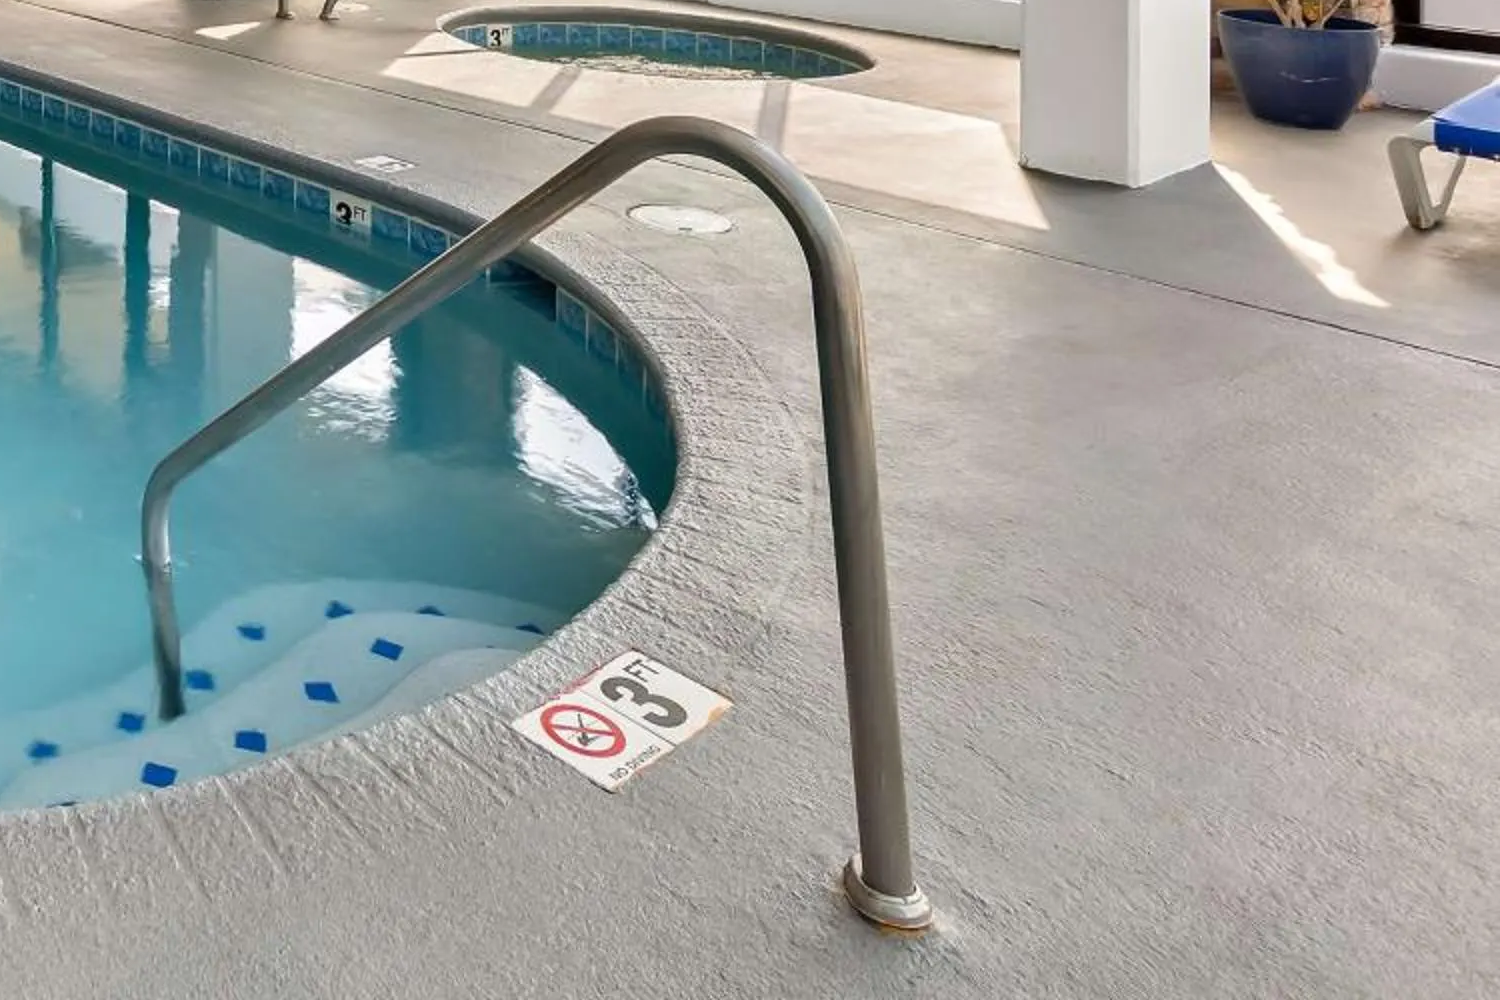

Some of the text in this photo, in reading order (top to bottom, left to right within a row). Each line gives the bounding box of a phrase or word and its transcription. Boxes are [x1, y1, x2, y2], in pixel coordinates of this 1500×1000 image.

[490, 29, 501, 47] 3
[353, 205, 367, 222] FT
[600, 659, 687, 729] 3 FT
